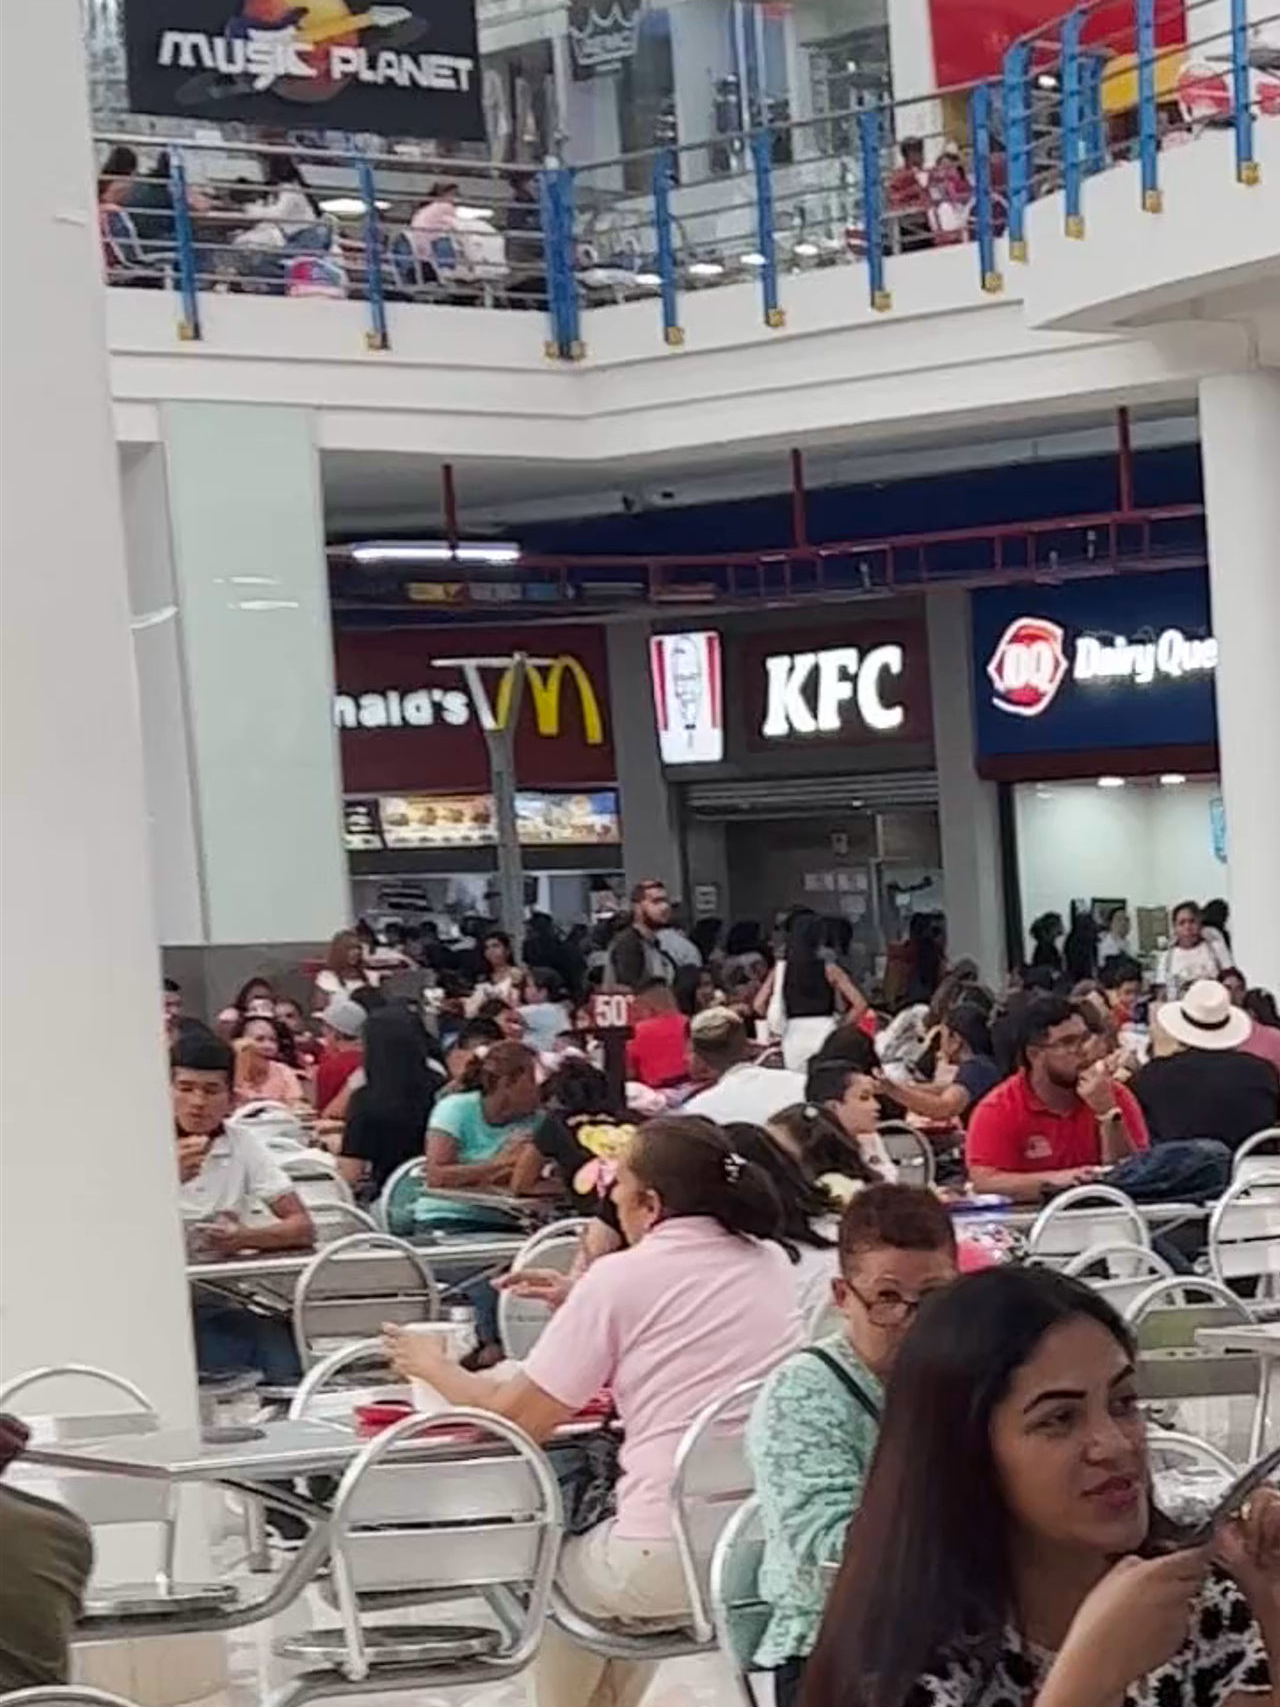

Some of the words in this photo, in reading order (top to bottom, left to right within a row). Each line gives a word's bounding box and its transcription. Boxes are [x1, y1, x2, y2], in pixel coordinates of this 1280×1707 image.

[329, 45, 474, 92] PLANET
[1073, 634, 1156, 683] Dairy
[762, 643, 904, 739] KFC
[595, 994, 628, 1028] 50
